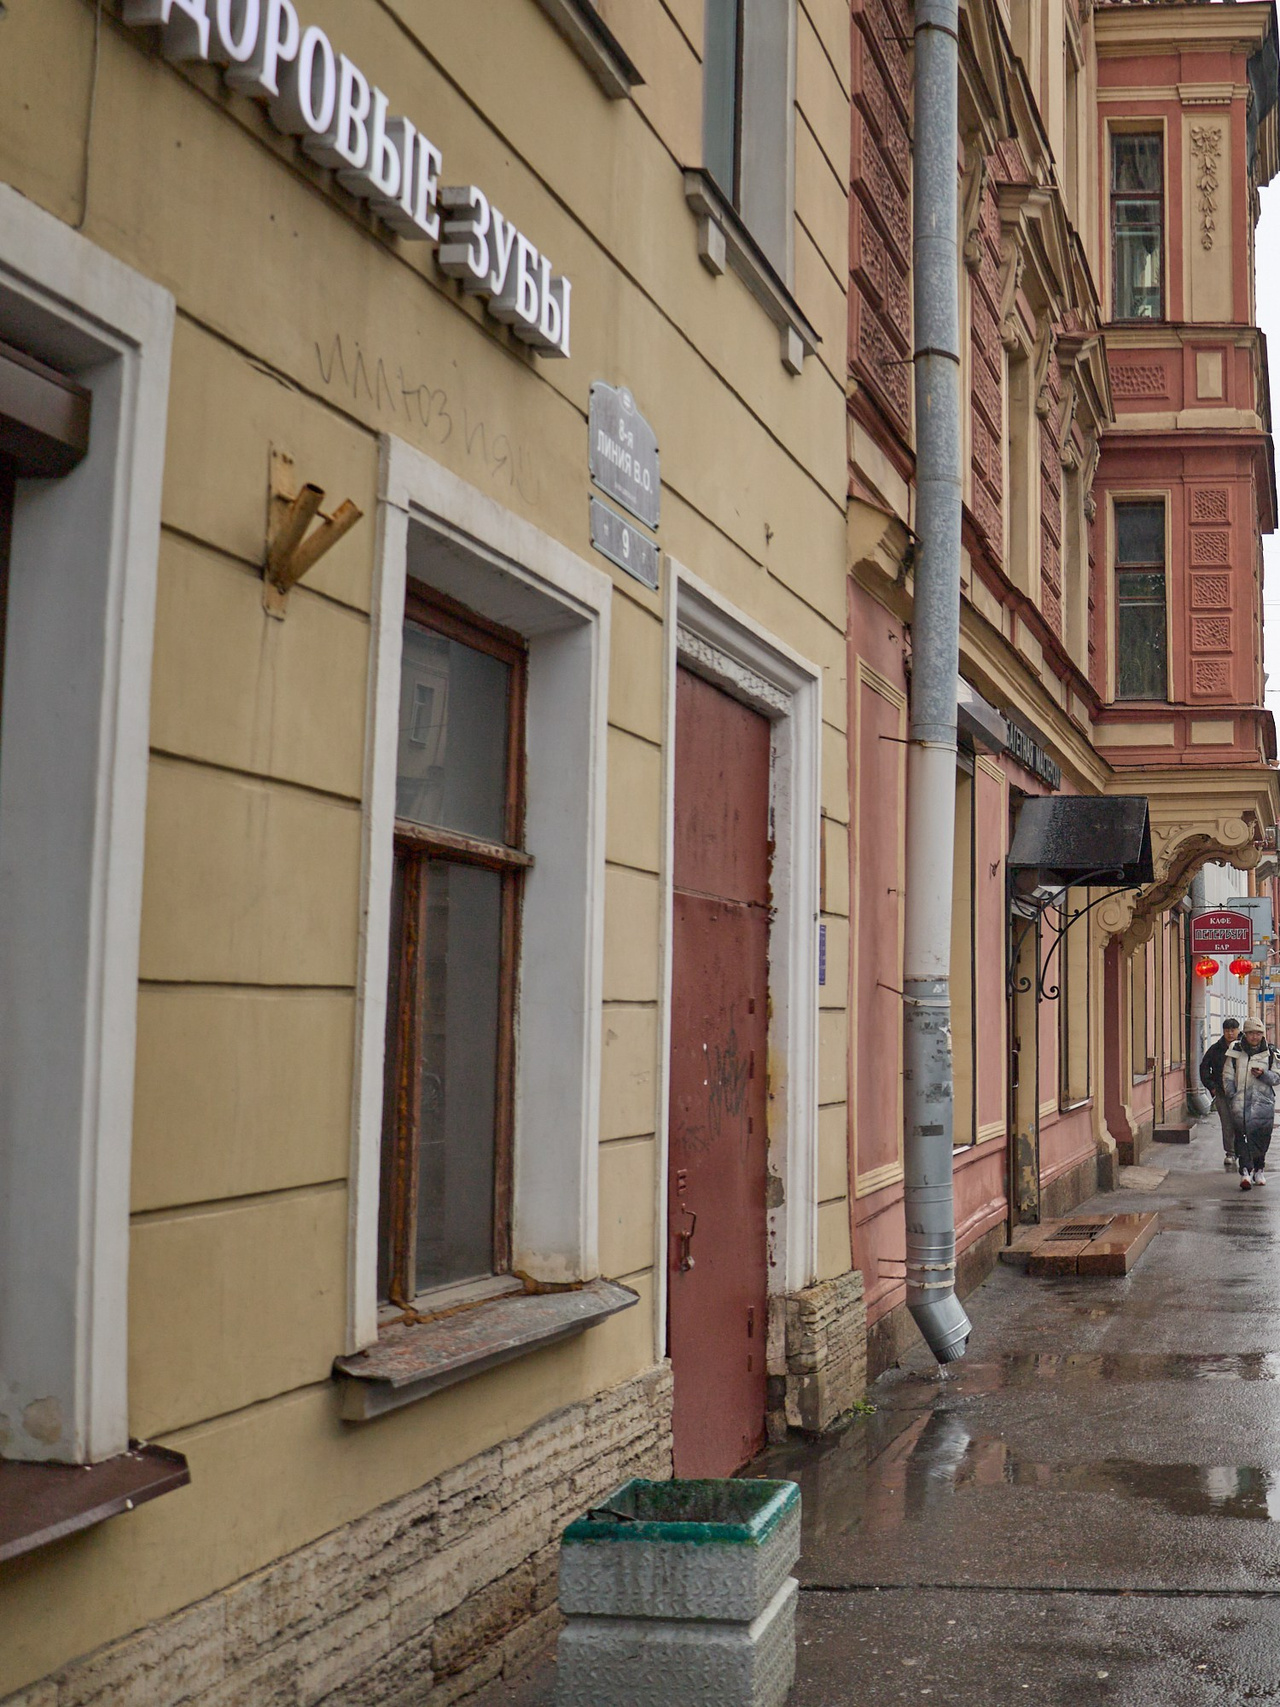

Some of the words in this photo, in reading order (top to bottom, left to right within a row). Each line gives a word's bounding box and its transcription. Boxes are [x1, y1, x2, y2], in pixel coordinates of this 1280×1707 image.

[468, 185, 571, 358] ЗУБЫ
[618, 418, 634, 449] 8-я
[597, 429, 632, 478] ЛИНИЯ
[634, 458, 653, 495] В.О.
[621, 528, 630, 558] 9
[1195, 928, 1248, 940] ПЕТЕРБУРГ
